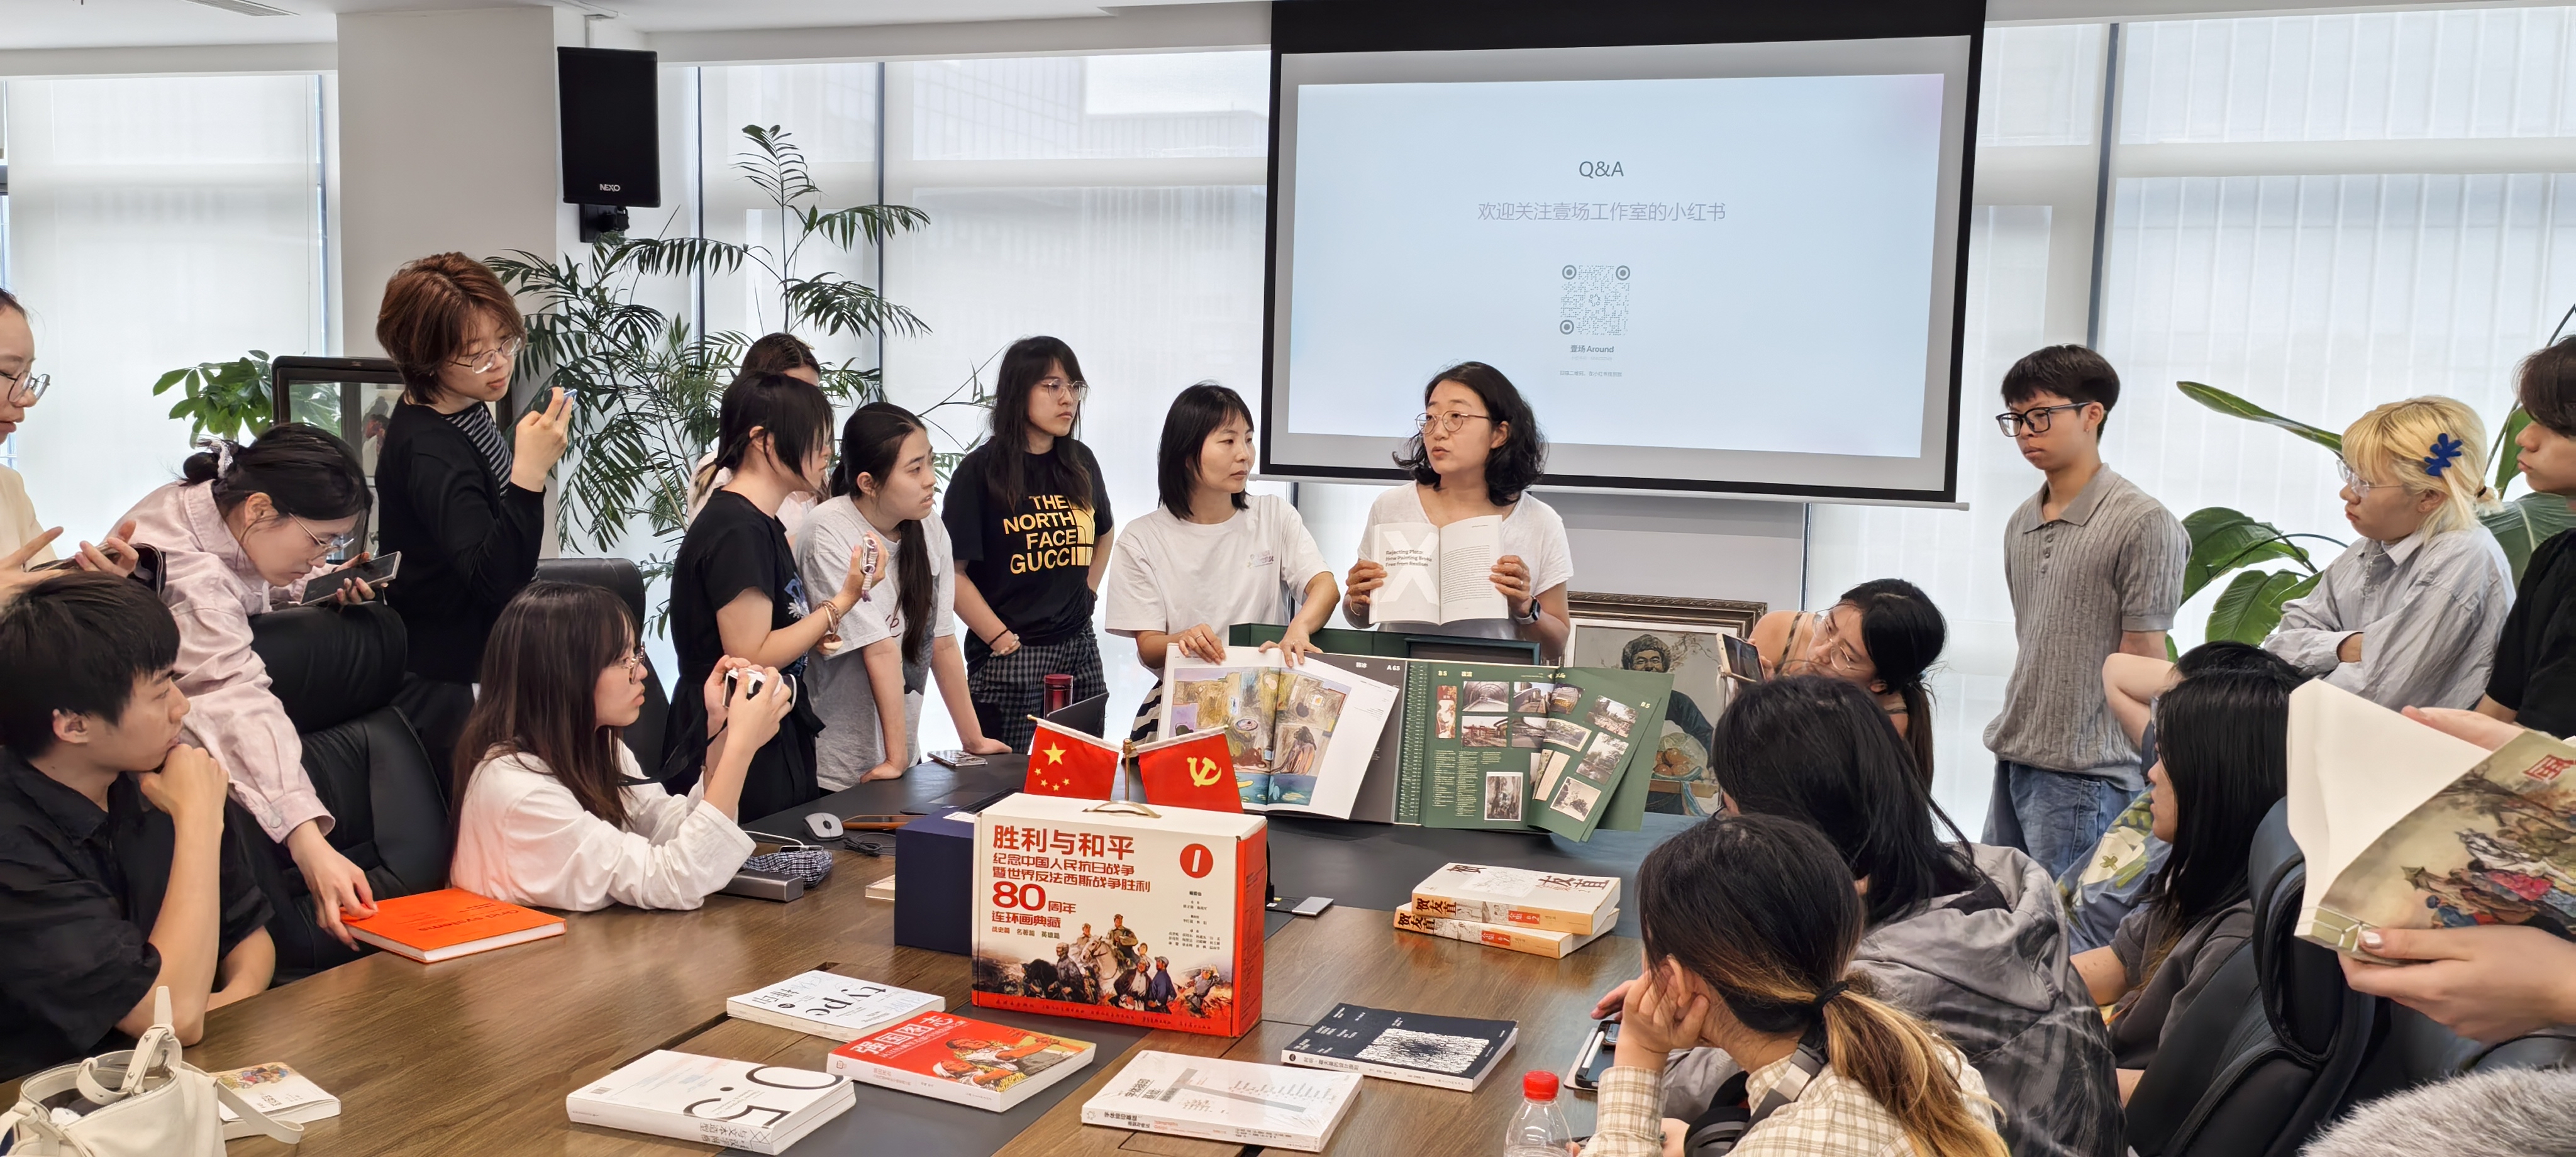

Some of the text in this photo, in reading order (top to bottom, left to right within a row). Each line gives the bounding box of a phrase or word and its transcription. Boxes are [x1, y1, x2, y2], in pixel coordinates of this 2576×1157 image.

[1579, 161, 1624, 179] Q&A
[600, 184, 621, 192] NEXO
[1478, 202, 1726, 222] 欢迎关注壹场工作室的小红书
[1570, 345, 1585, 353] 壹场
[1028, 495, 1069, 510] THE
[1003, 511, 1076, 534] NORTH
[1026, 529, 1077, 550] FACE
[1010, 547, 1076, 575] GUCCI
[993, 824, 1135, 861] 胜利与和平
[993, 852, 1135, 877] 纪念中国人民抗日战争
[992, 866, 1151, 893] 暨世界反法西斯战争胜利
[992, 881, 1077, 914] 80 周年
[1416, 897, 1457, 916] 贺友直
[419, 916, 484, 932] systems
[992, 911, 1061, 929] 连环画典藏
[1398, 912, 1435, 934] 贺友直
[806, 986, 886, 1016] type
[850, 1016, 954, 1055] 强国图志
